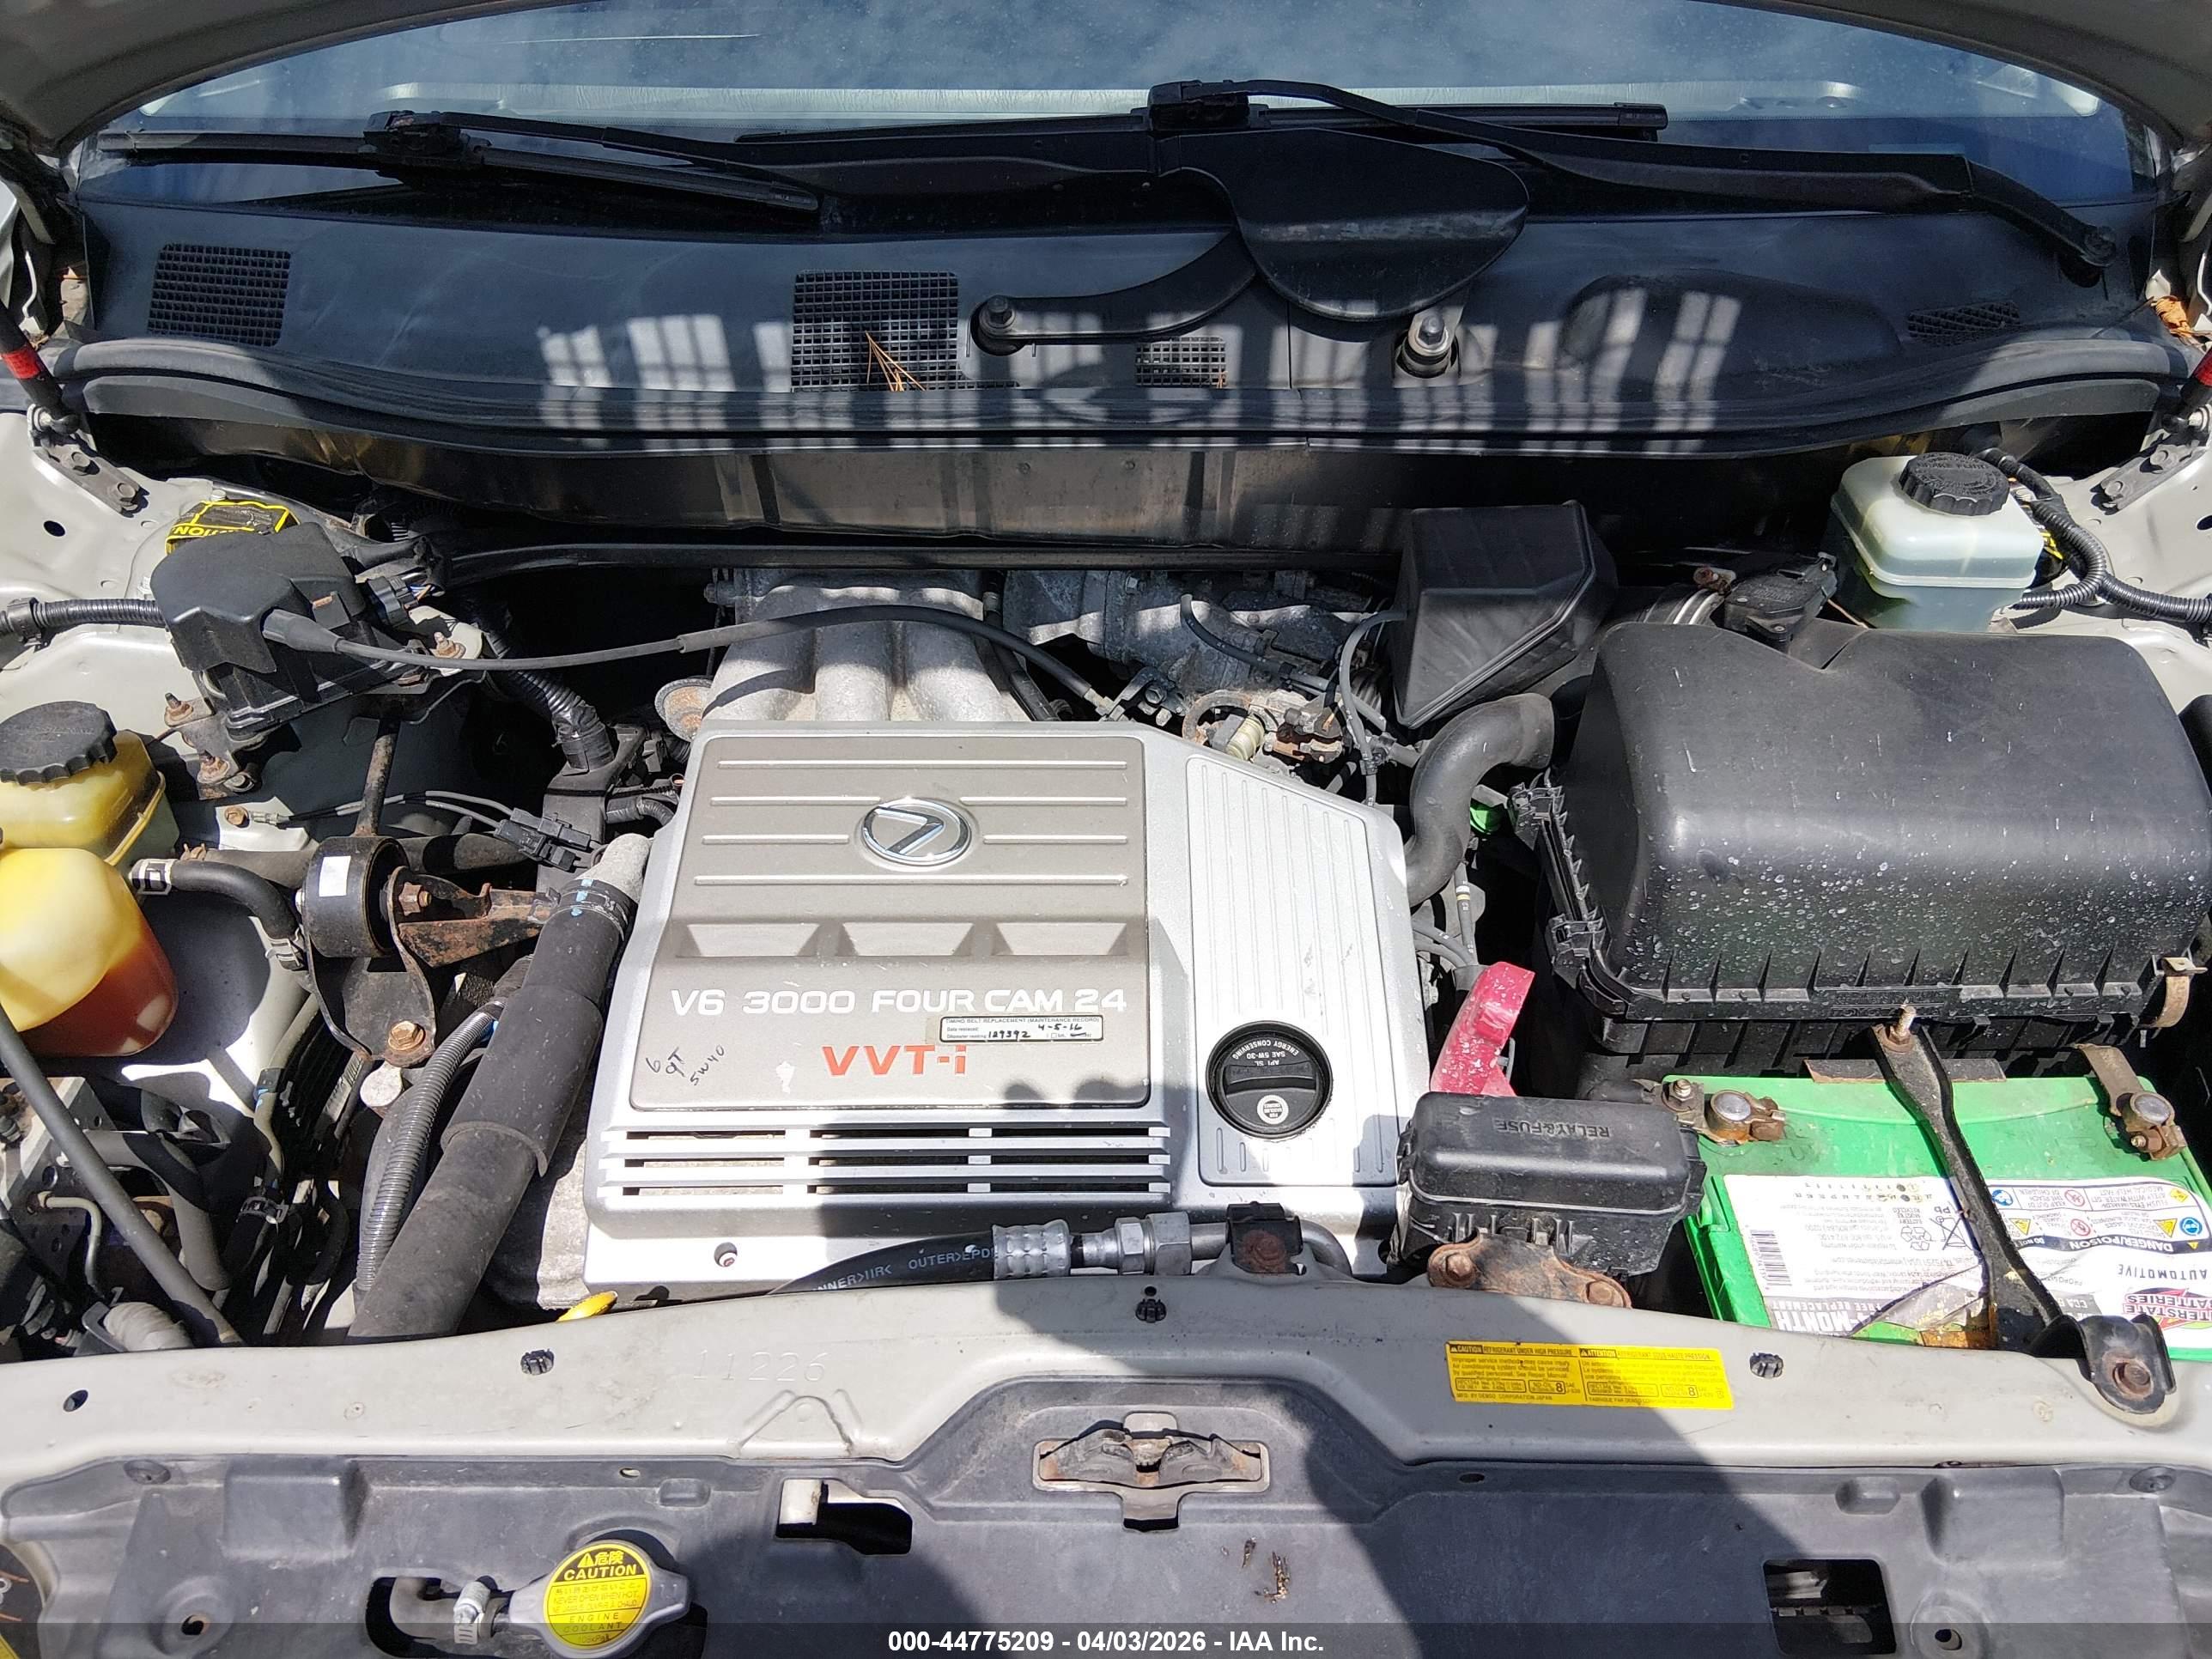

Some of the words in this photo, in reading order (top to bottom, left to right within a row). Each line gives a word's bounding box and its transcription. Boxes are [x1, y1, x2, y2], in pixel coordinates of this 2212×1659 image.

[671, 989, 726, 1016] V6
[742, 989, 856, 1015] 3000
[872, 989, 974, 1013] FOUR
[985, 989, 1063, 1012] CAM
[1074, 988, 1127, 1012] 24
[1232, 1040, 1271, 1059] CONSERVING
[1273, 1040, 1298, 1056] ENERGY
[822, 1044, 968, 1076] VVT-i
[1496, 1118, 1610, 1139] RELAY&FUSE
[1933, 1206, 1951, 1214] Pb
[2069, 1236, 2174, 1252] DANGER/POISON
[908, 1247, 996, 1271] OUTER>EPD
[812, 1264, 892, 1291] NNER>IIR<
[2118, 1264, 2207, 1280] AUTOMOTIVE
[2124, 1304, 2212, 1322] TERSTATE
[1457, 1345, 1482, 1353] CAUTION
[693, 1347, 830, 1382] 11226
[1555, 1382, 1564, 1392] 8
[1687, 1386, 1696, 1396] 8
[594, 1550, 624, 1566] 危険
[563, 1564, 637, 1582] CAUTION
[568, 1612, 620, 1623] ENGINE
[562, 1621, 623, 1632] COOLANT
